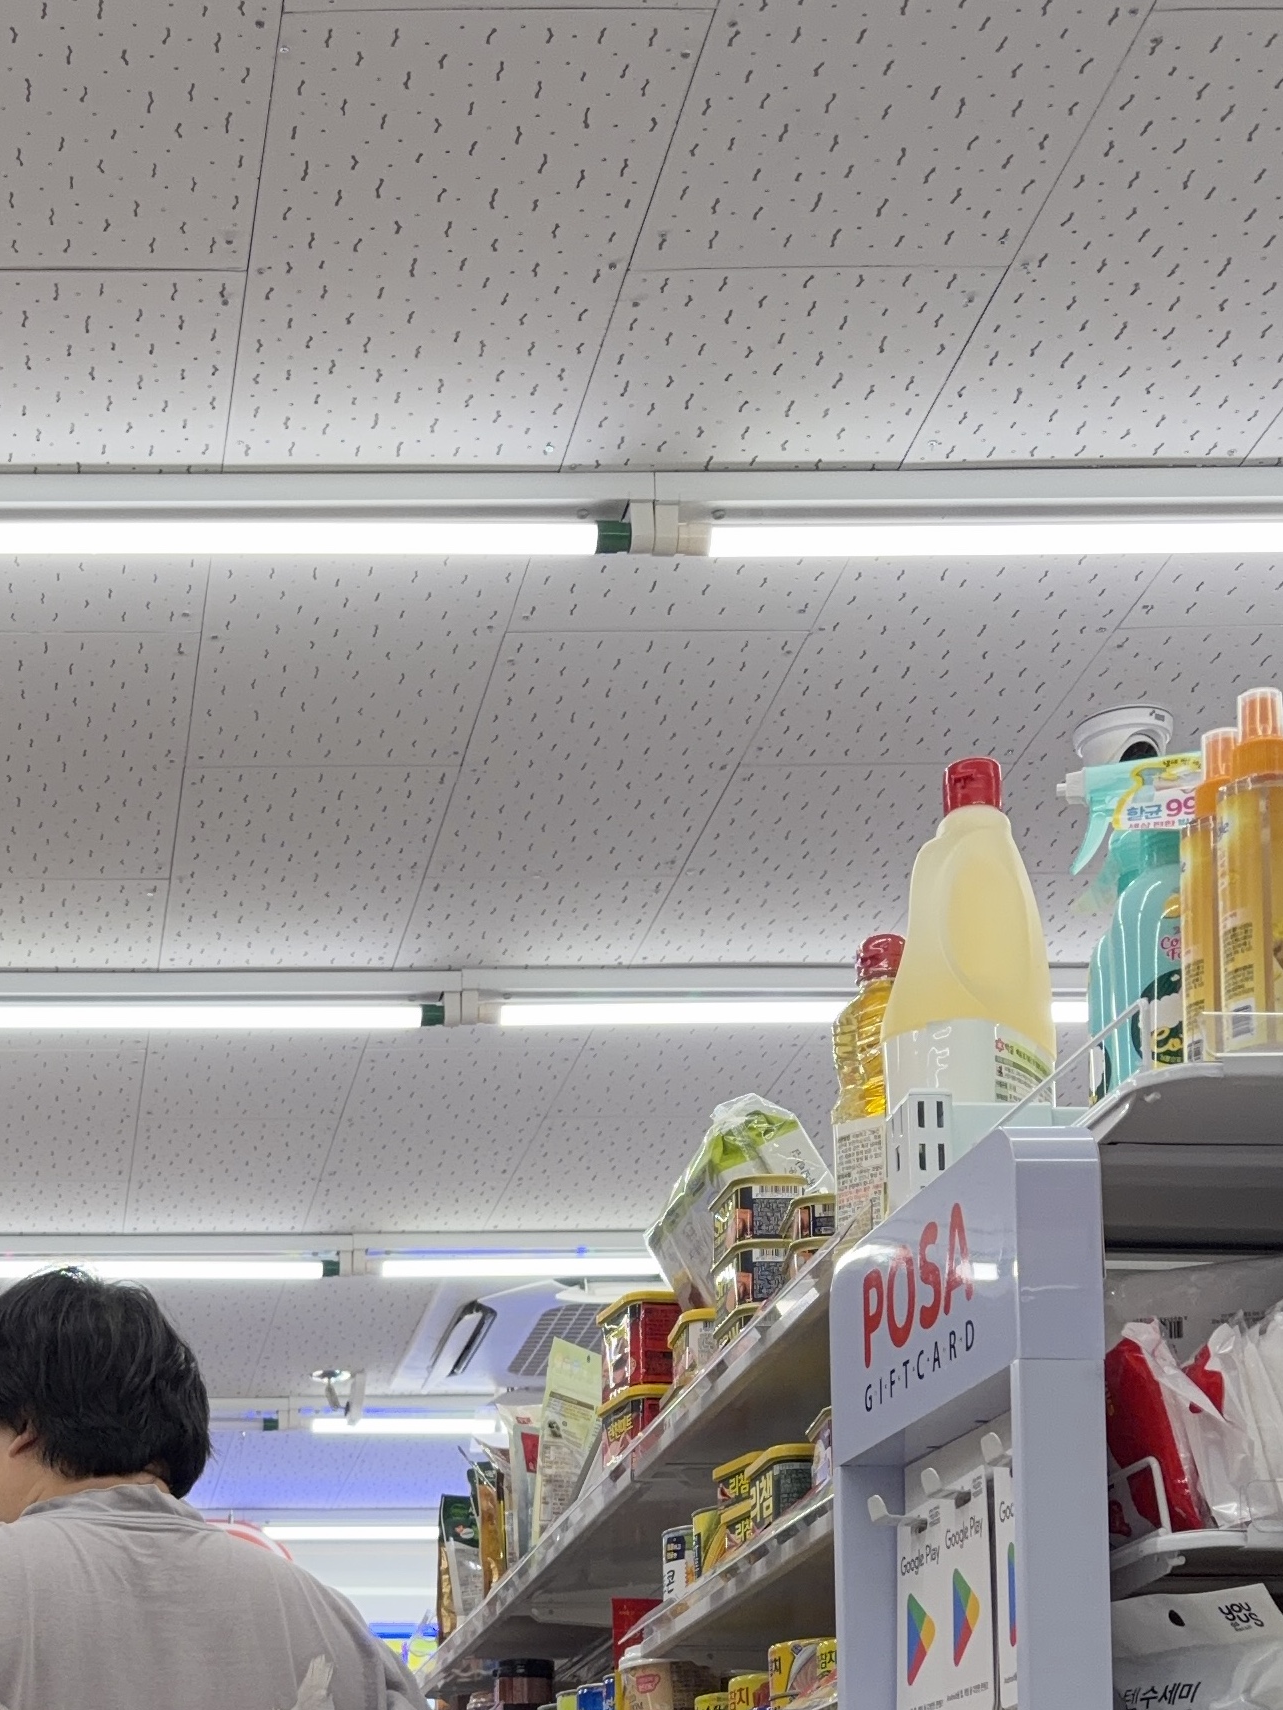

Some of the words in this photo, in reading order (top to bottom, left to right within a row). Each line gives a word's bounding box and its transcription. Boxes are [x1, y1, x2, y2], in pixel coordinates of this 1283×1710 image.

[863, 1202, 974, 1369] POSA
[945, 1527, 970, 1550] Google
[969, 1516, 984, 1539] Play
[900, 1552, 925, 1576] Google
[925, 1543, 941, 1566] Play
